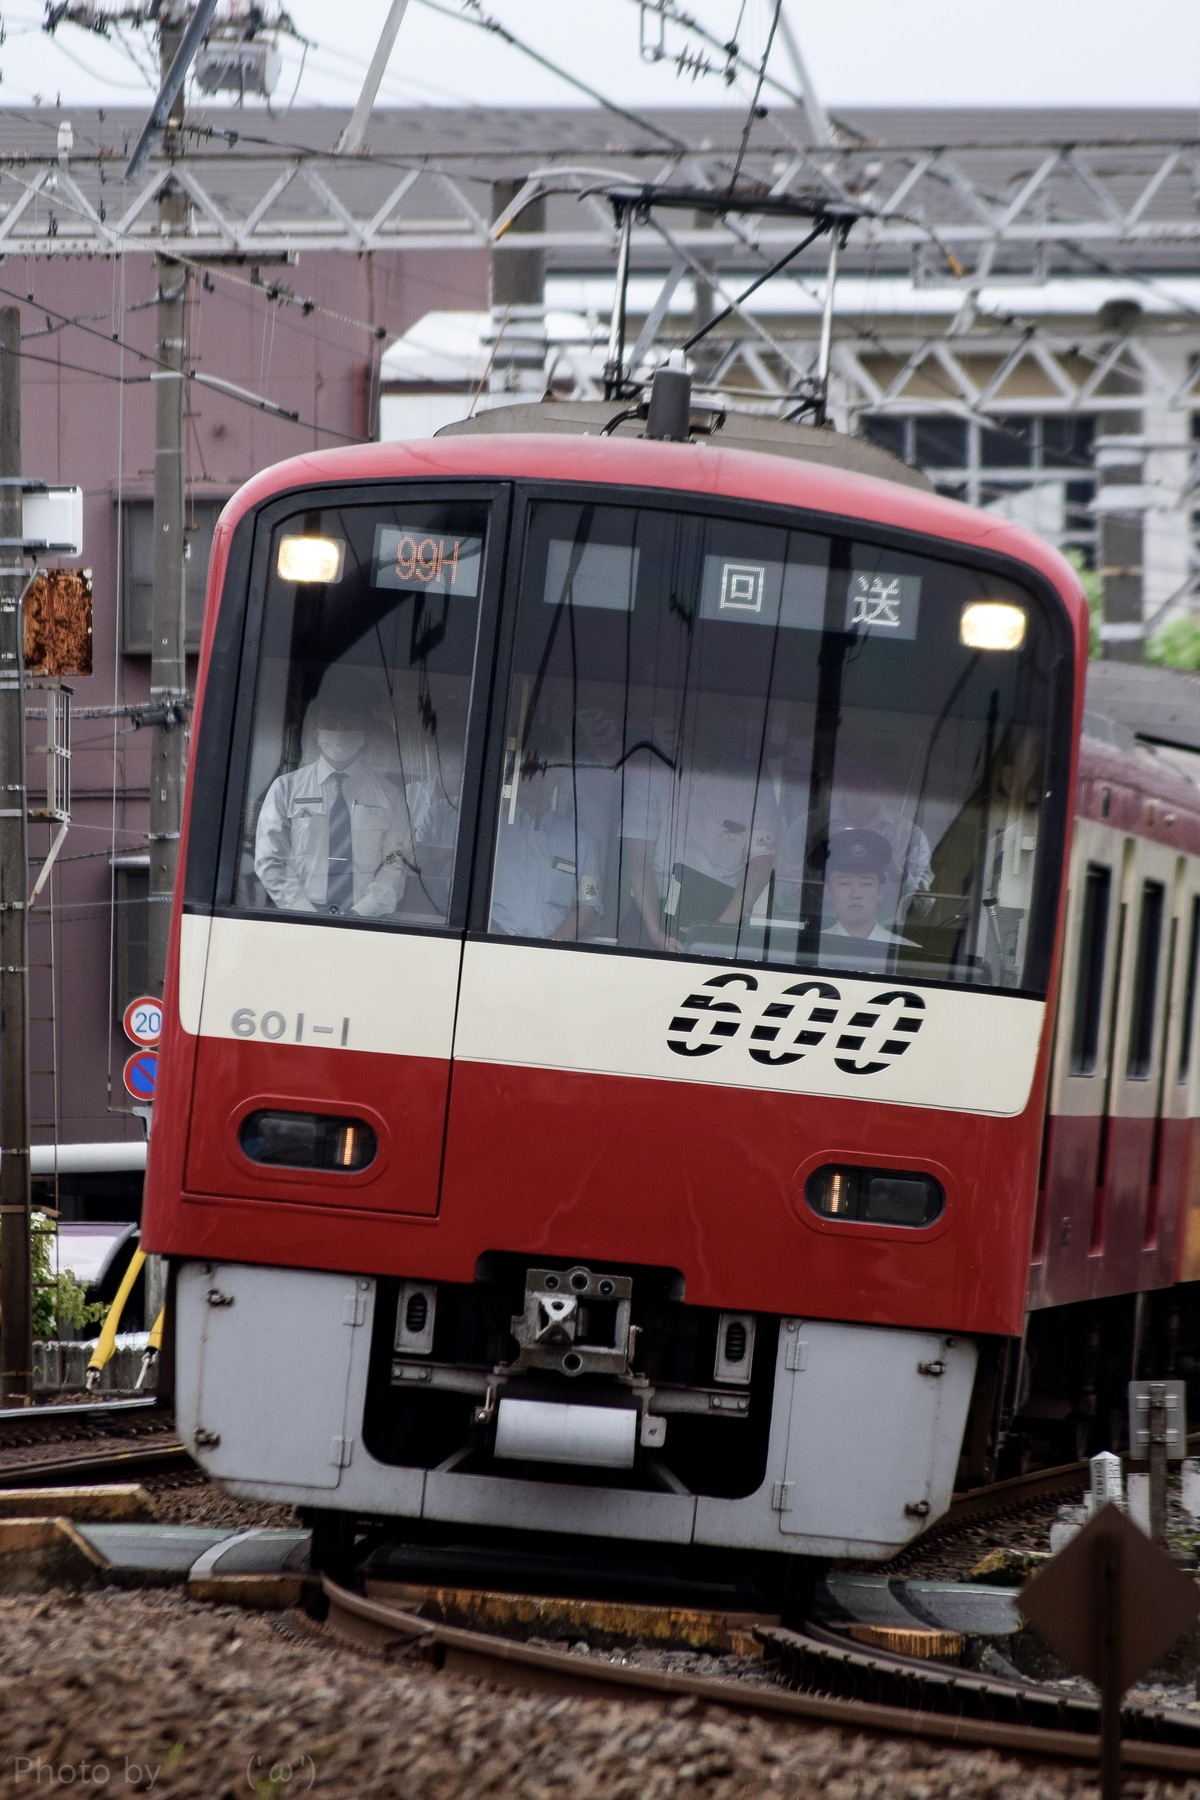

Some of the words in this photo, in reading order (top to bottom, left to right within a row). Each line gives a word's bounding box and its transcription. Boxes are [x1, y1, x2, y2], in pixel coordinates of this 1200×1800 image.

[395, 536, 460, 584] 99H
[135, 1012, 161, 1033] 20
[230, 1007, 350, 1047] 601-1
[666, 972, 927, 1075] 600
